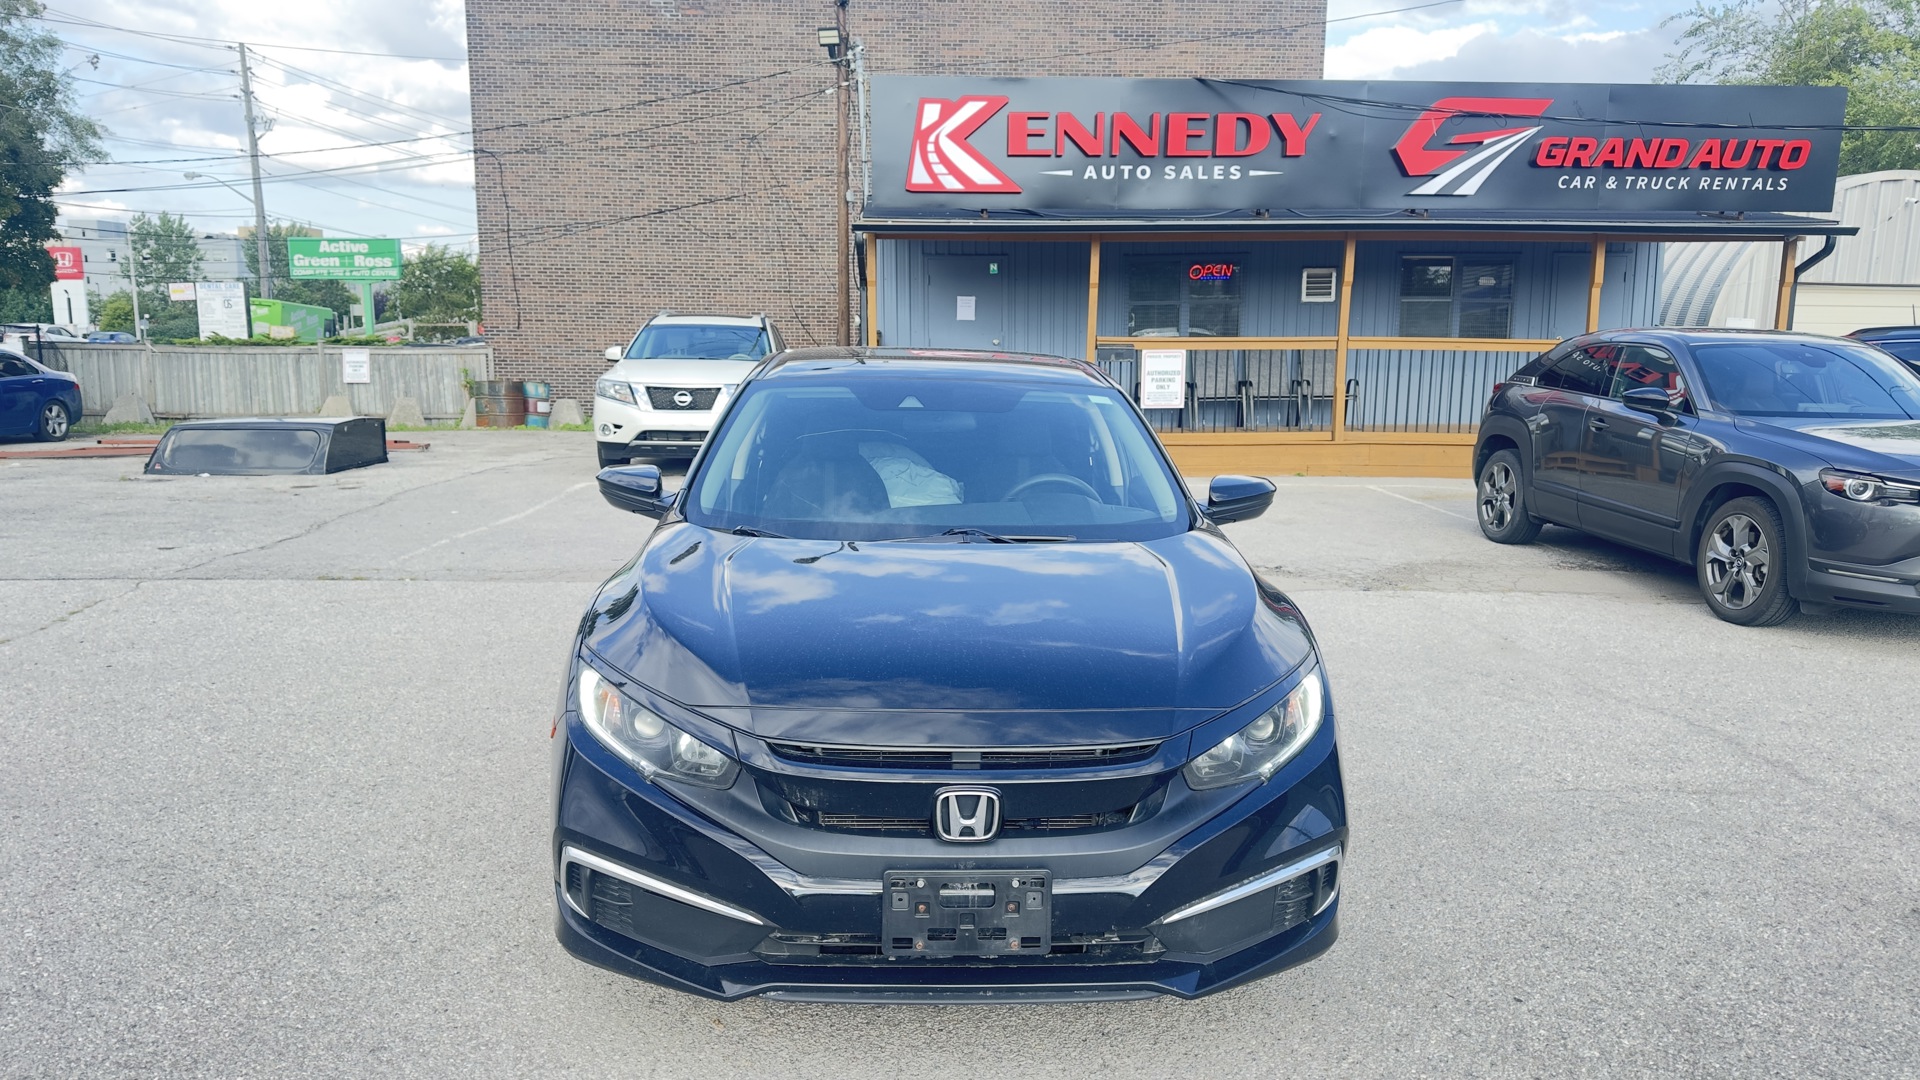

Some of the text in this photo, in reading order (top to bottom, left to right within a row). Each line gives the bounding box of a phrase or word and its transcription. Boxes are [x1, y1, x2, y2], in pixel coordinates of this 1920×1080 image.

[905, 95, 1322, 194] KENNEDY
[1083, 165, 1242, 180] AUTO SALES
[1558, 175, 1788, 191] CAR & TRUCK RENTALS
[319, 240, 369, 253] Active
[293, 254, 340, 267] Green
[354, 255, 393, 267] Ross
[1189, 264, 1233, 280] OPEN
